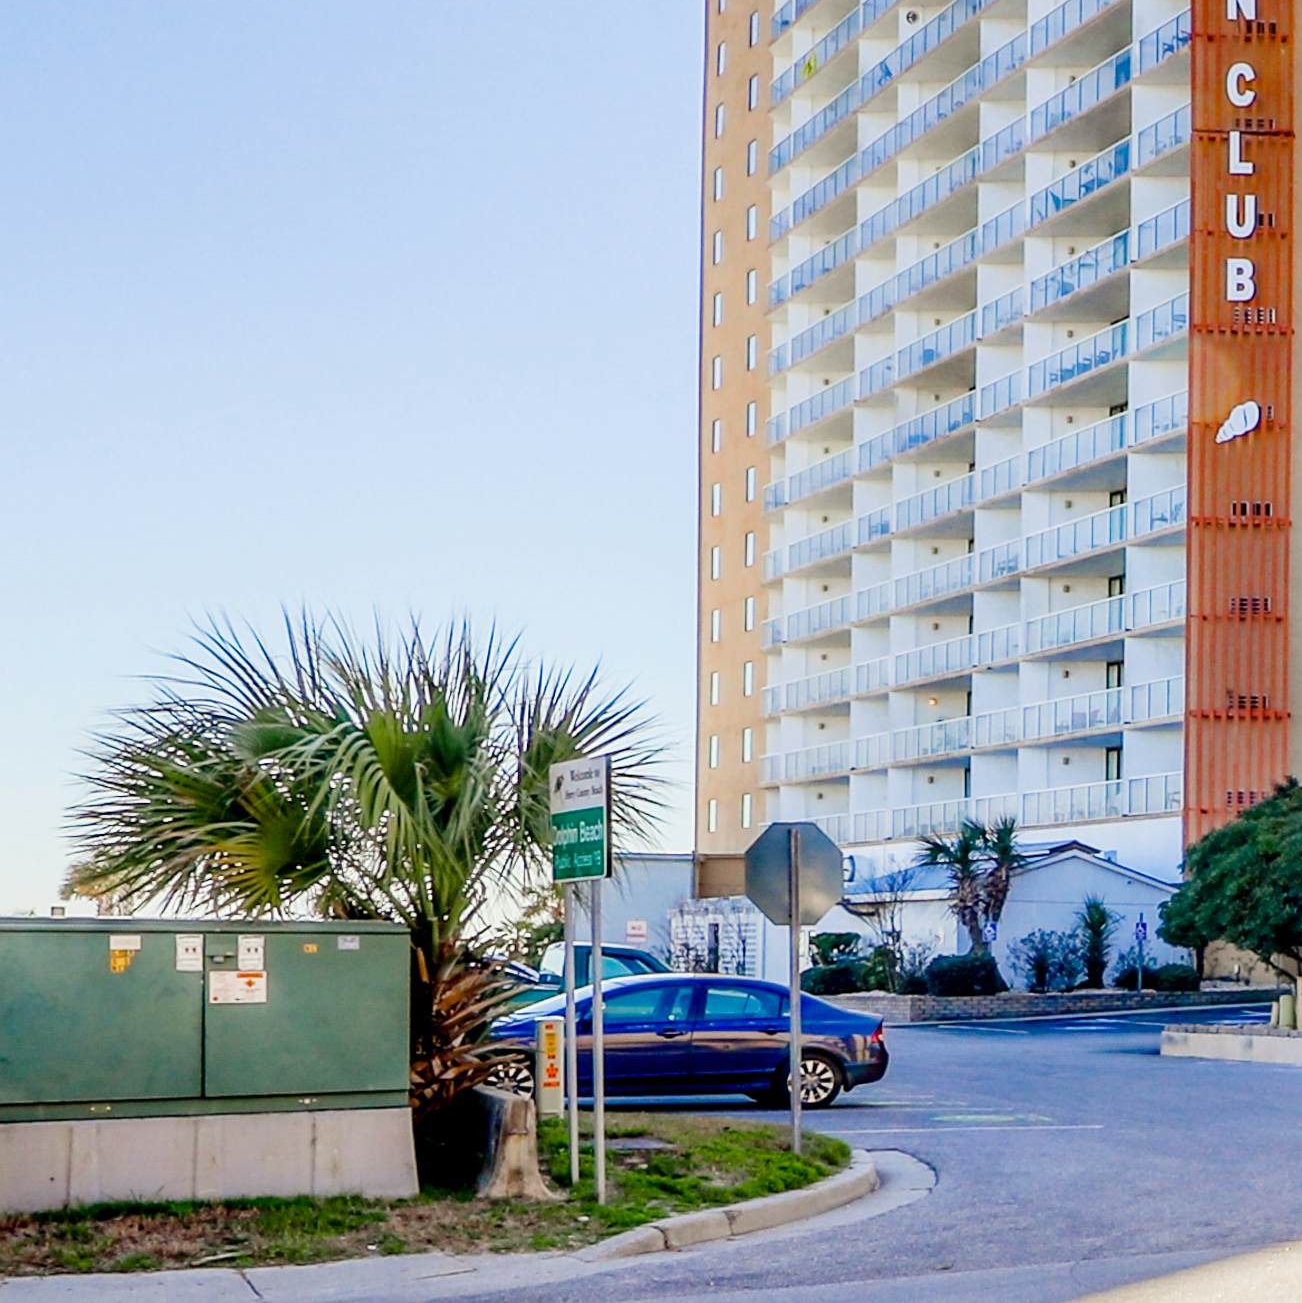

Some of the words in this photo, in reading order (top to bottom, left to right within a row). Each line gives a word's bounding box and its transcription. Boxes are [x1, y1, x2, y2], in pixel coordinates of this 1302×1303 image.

[1225, 62, 1258, 303] CLUB
[552, 822, 578, 850] Dolphin
[579, 818, 603, 843] Beach
